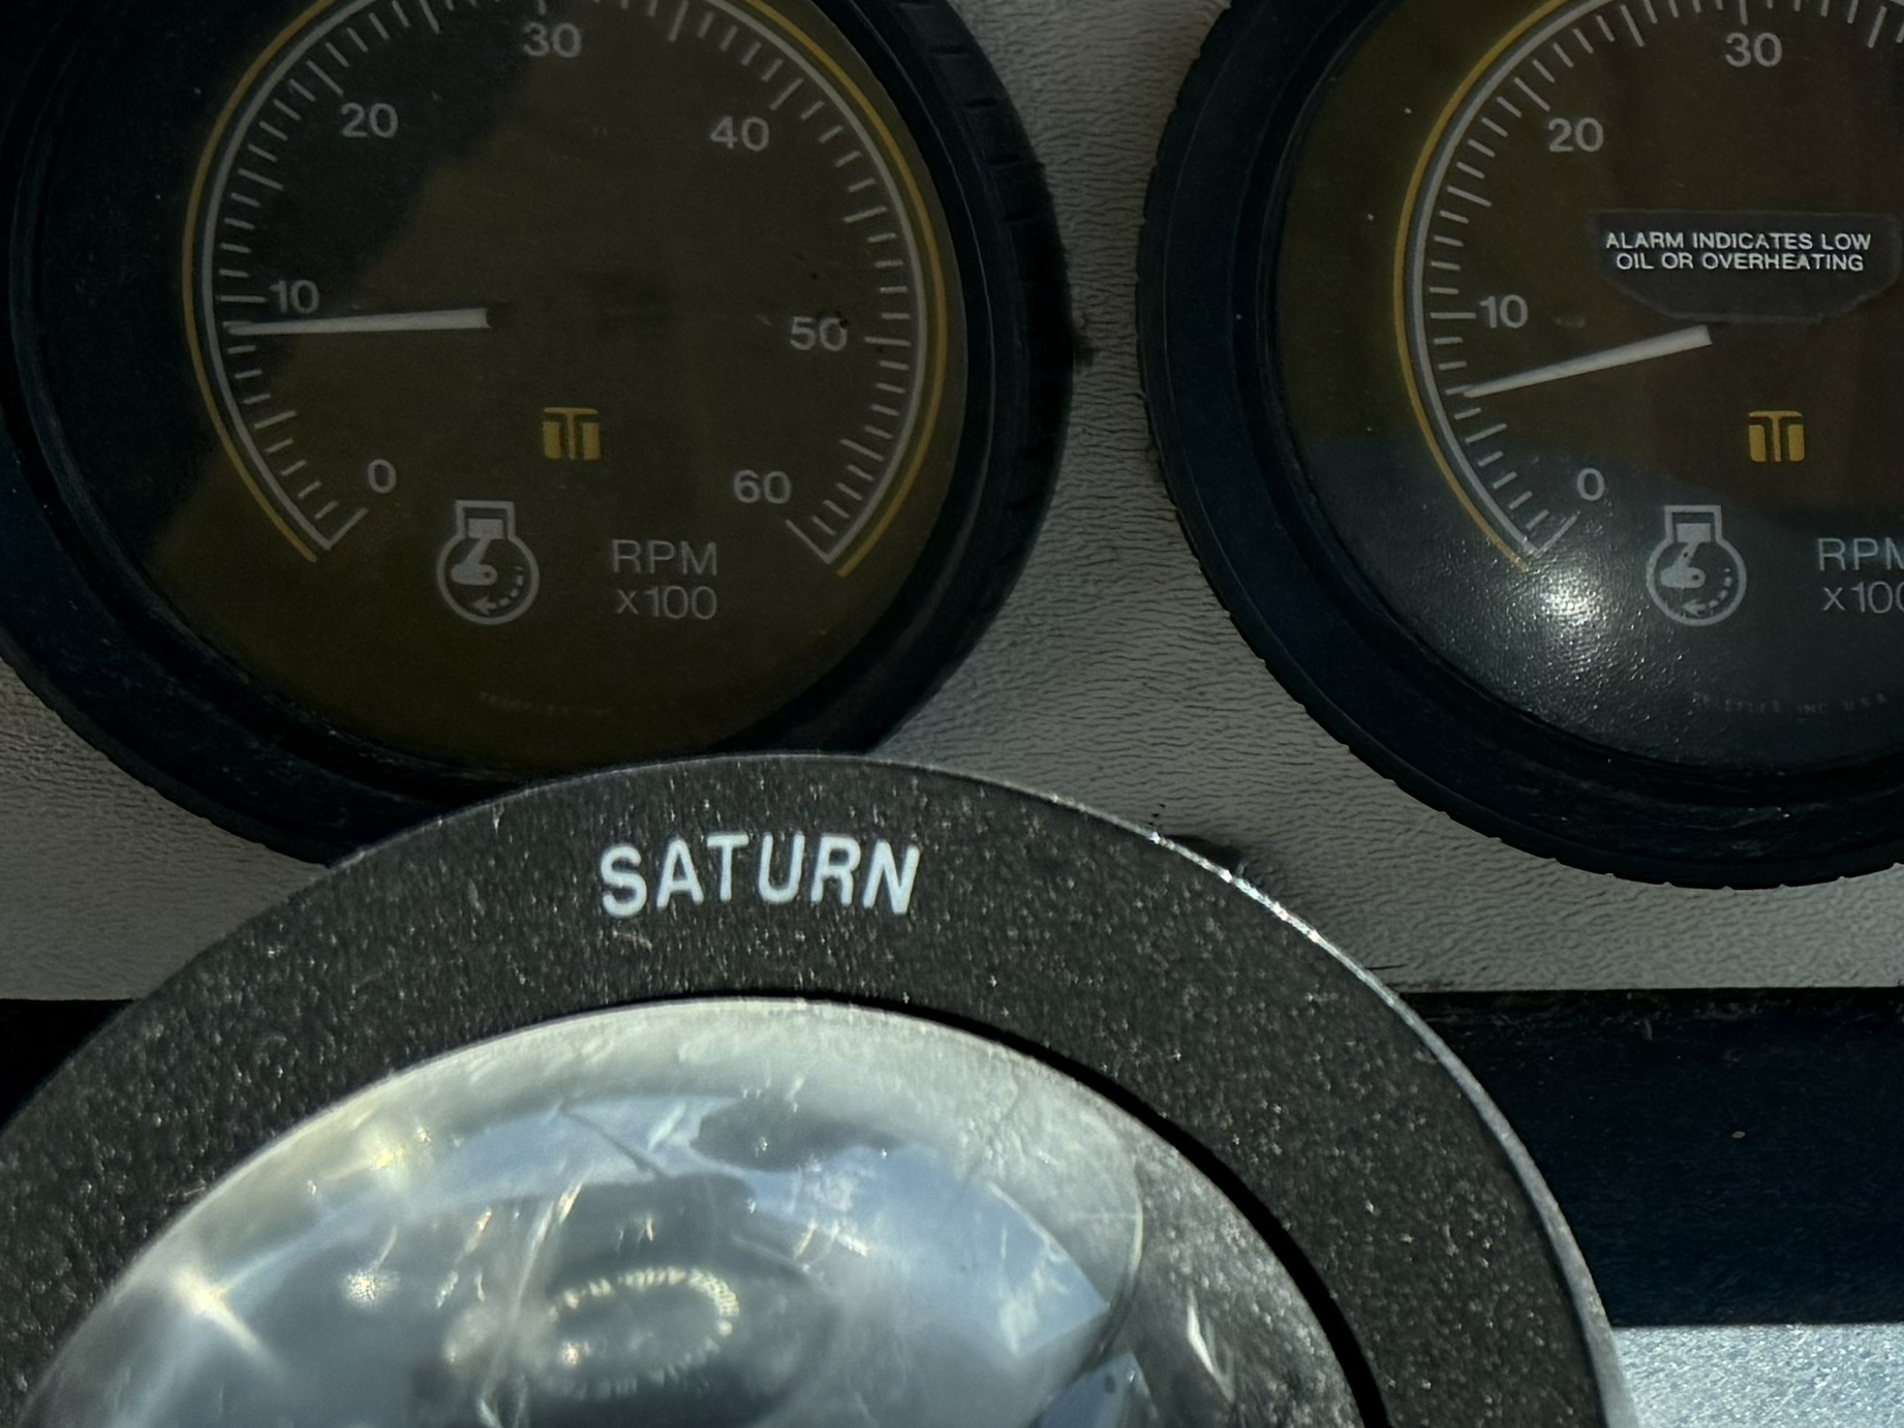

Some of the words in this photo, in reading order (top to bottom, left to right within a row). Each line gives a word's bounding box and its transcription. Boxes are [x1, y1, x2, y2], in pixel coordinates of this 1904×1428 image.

[523, 22, 583, 59] 30
[1724, 32, 1783, 68] 30
[340, 103, 399, 140] 20
[710, 116, 770, 152] 40
[1547, 117, 1605, 153] 20
[1606, 232, 1684, 249] ALARM
[1693, 232, 1813, 250] INDICATES
[1821, 233, 1871, 251] LOW
[1616, 252, 1654, 270] OIL
[1661, 252, 1694, 270] OR
[1702, 252, 1864, 271] OVERHEATING
[270, 280, 319, 315] 10
[1479, 294, 1529, 331] 10
[789, 315, 847, 353] 50
[367, 459, 396, 495] 0
[732, 469, 791, 505] 60
[1576, 467, 1606, 503] 0
[611, 541, 719, 576] RPM
[616, 585, 719, 622] x100
[600, 831, 921, 918] SATURN
